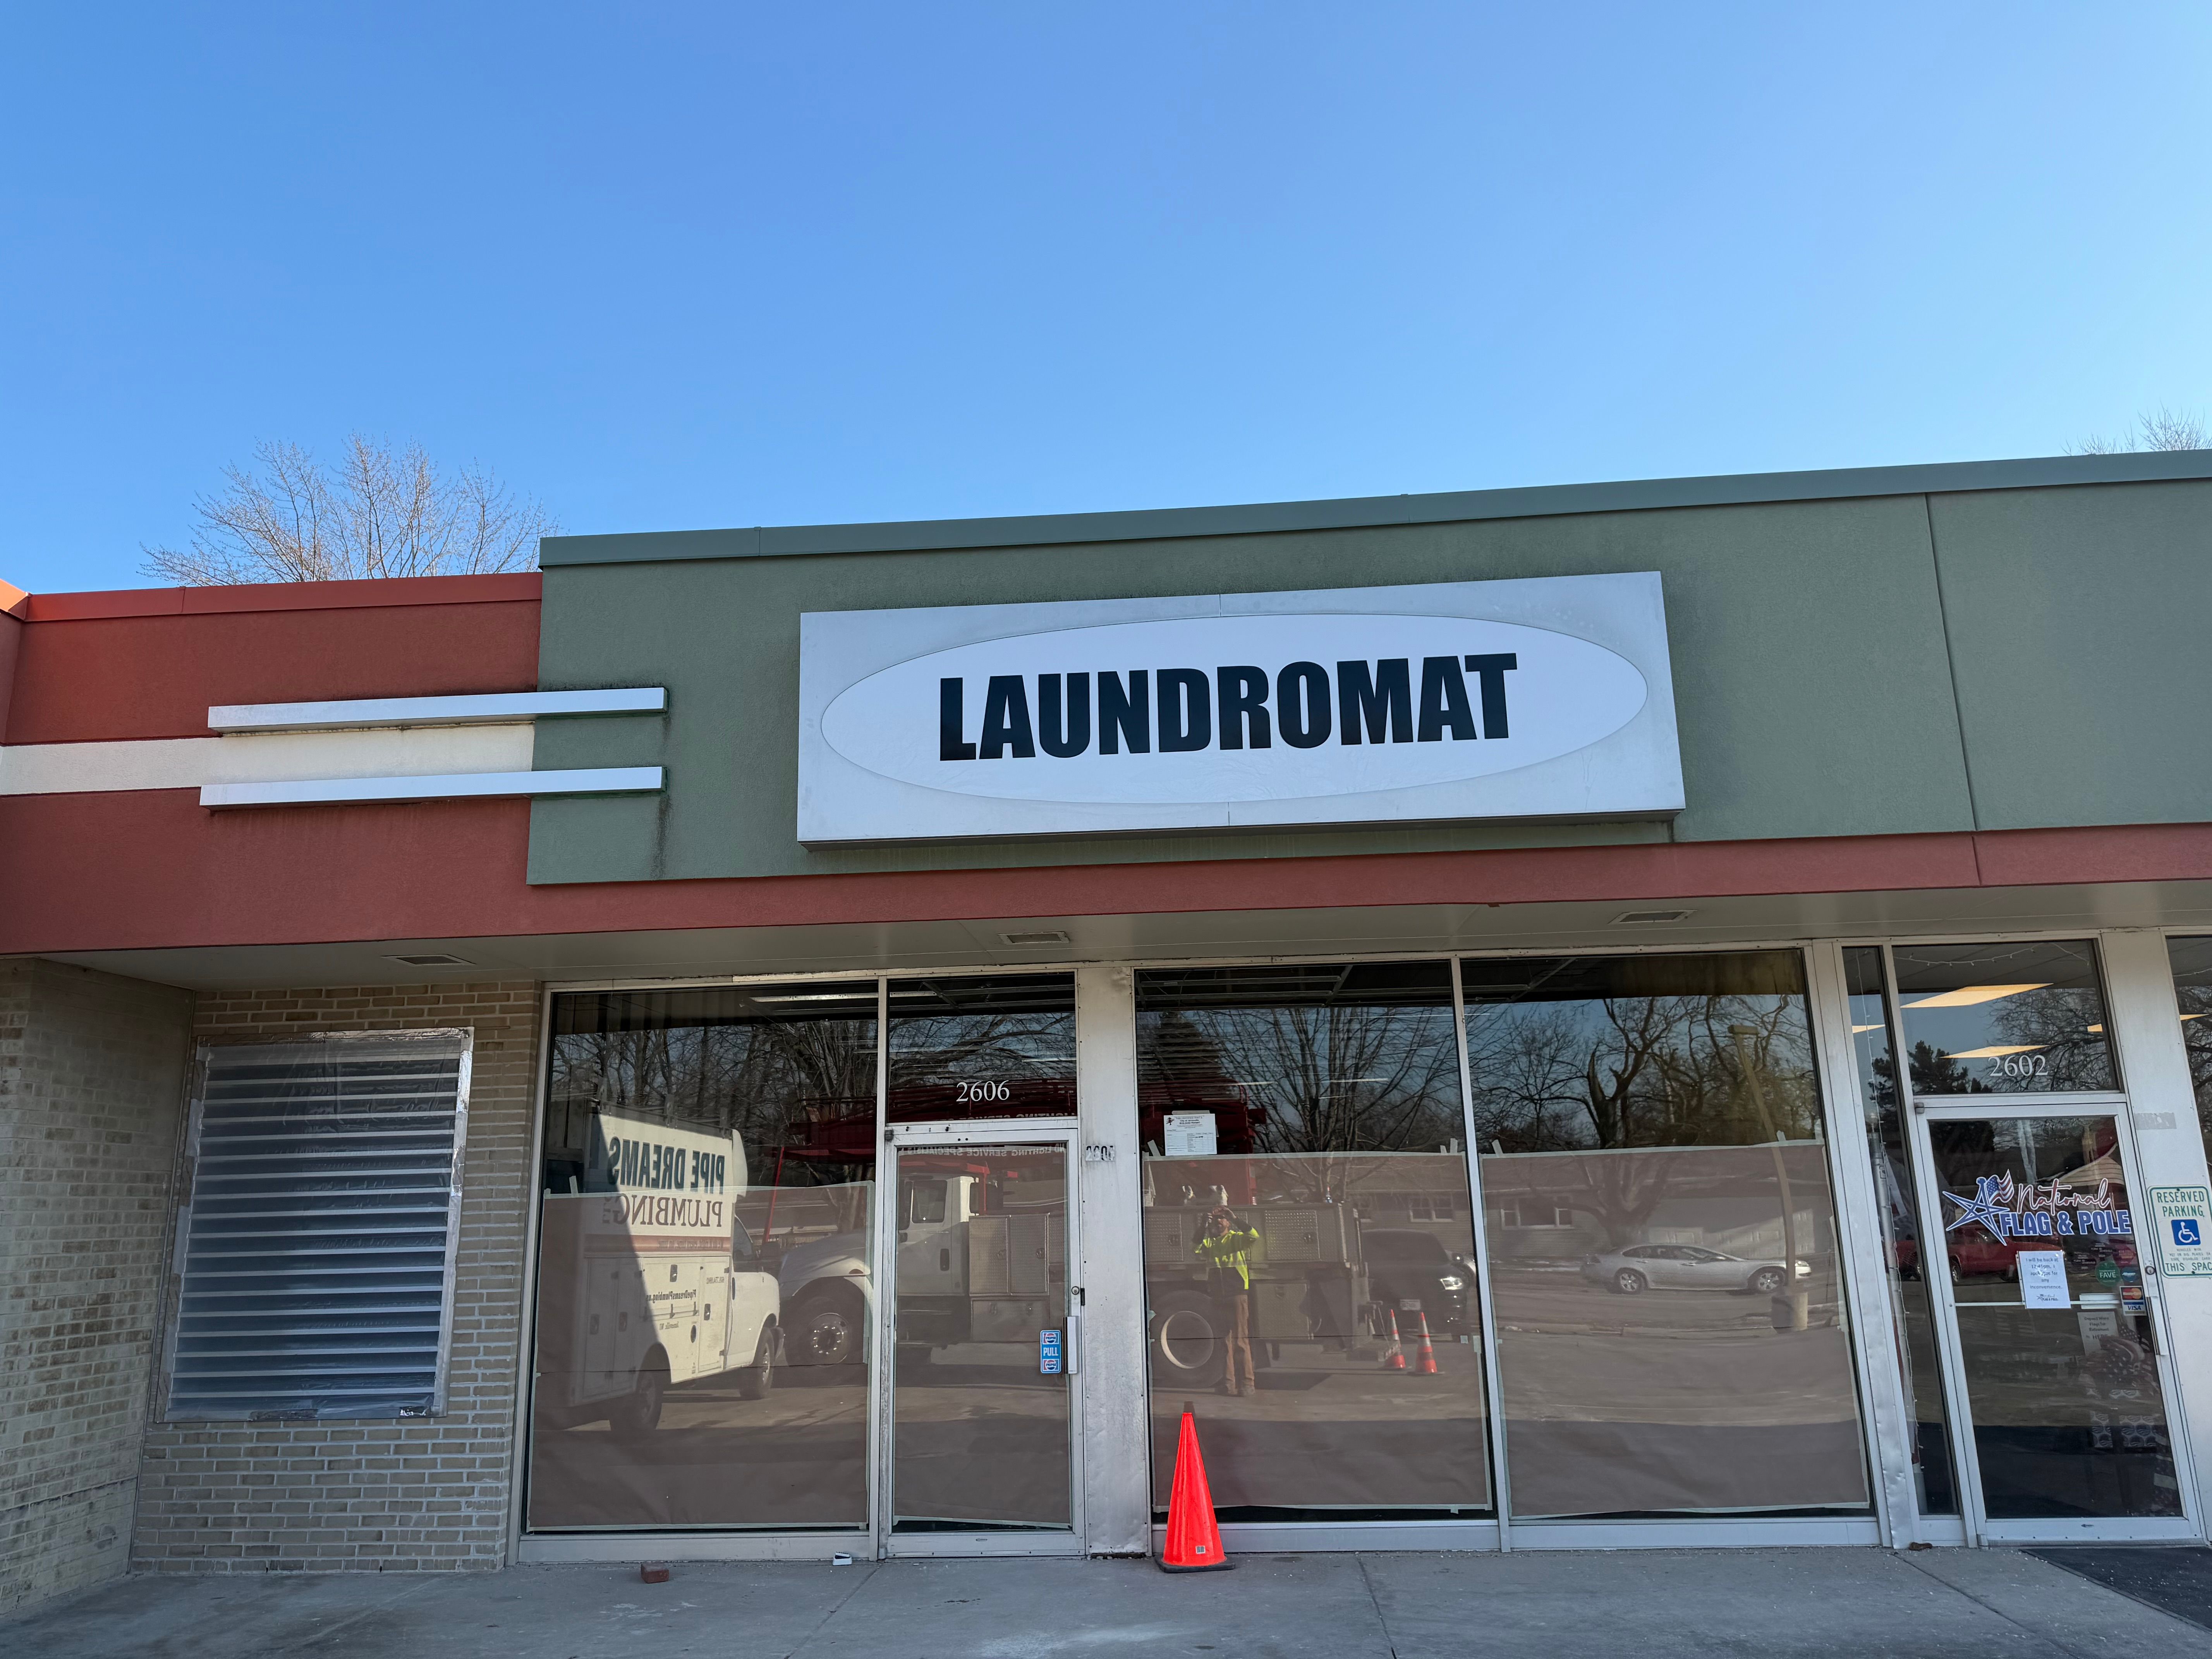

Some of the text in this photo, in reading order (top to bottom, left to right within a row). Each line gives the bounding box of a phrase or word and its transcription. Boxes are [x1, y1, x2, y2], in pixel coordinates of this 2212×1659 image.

[940, 653, 1517, 761] LAUNDROMAT
[1988, 1055, 2048, 1077] 2602
[956, 1080, 1010, 1102] 2606
[2016, 1178, 2111, 1216] National
[2156, 1191, 2205, 1203] RESERVED
[2162, 1205, 2203, 1217] PARKING
[1999, 1210, 2132, 1236] FLAG & POLE
[2165, 1262, 2212, 1271] THIS SPAC
[1043, 1347, 1059, 1356] PULL
